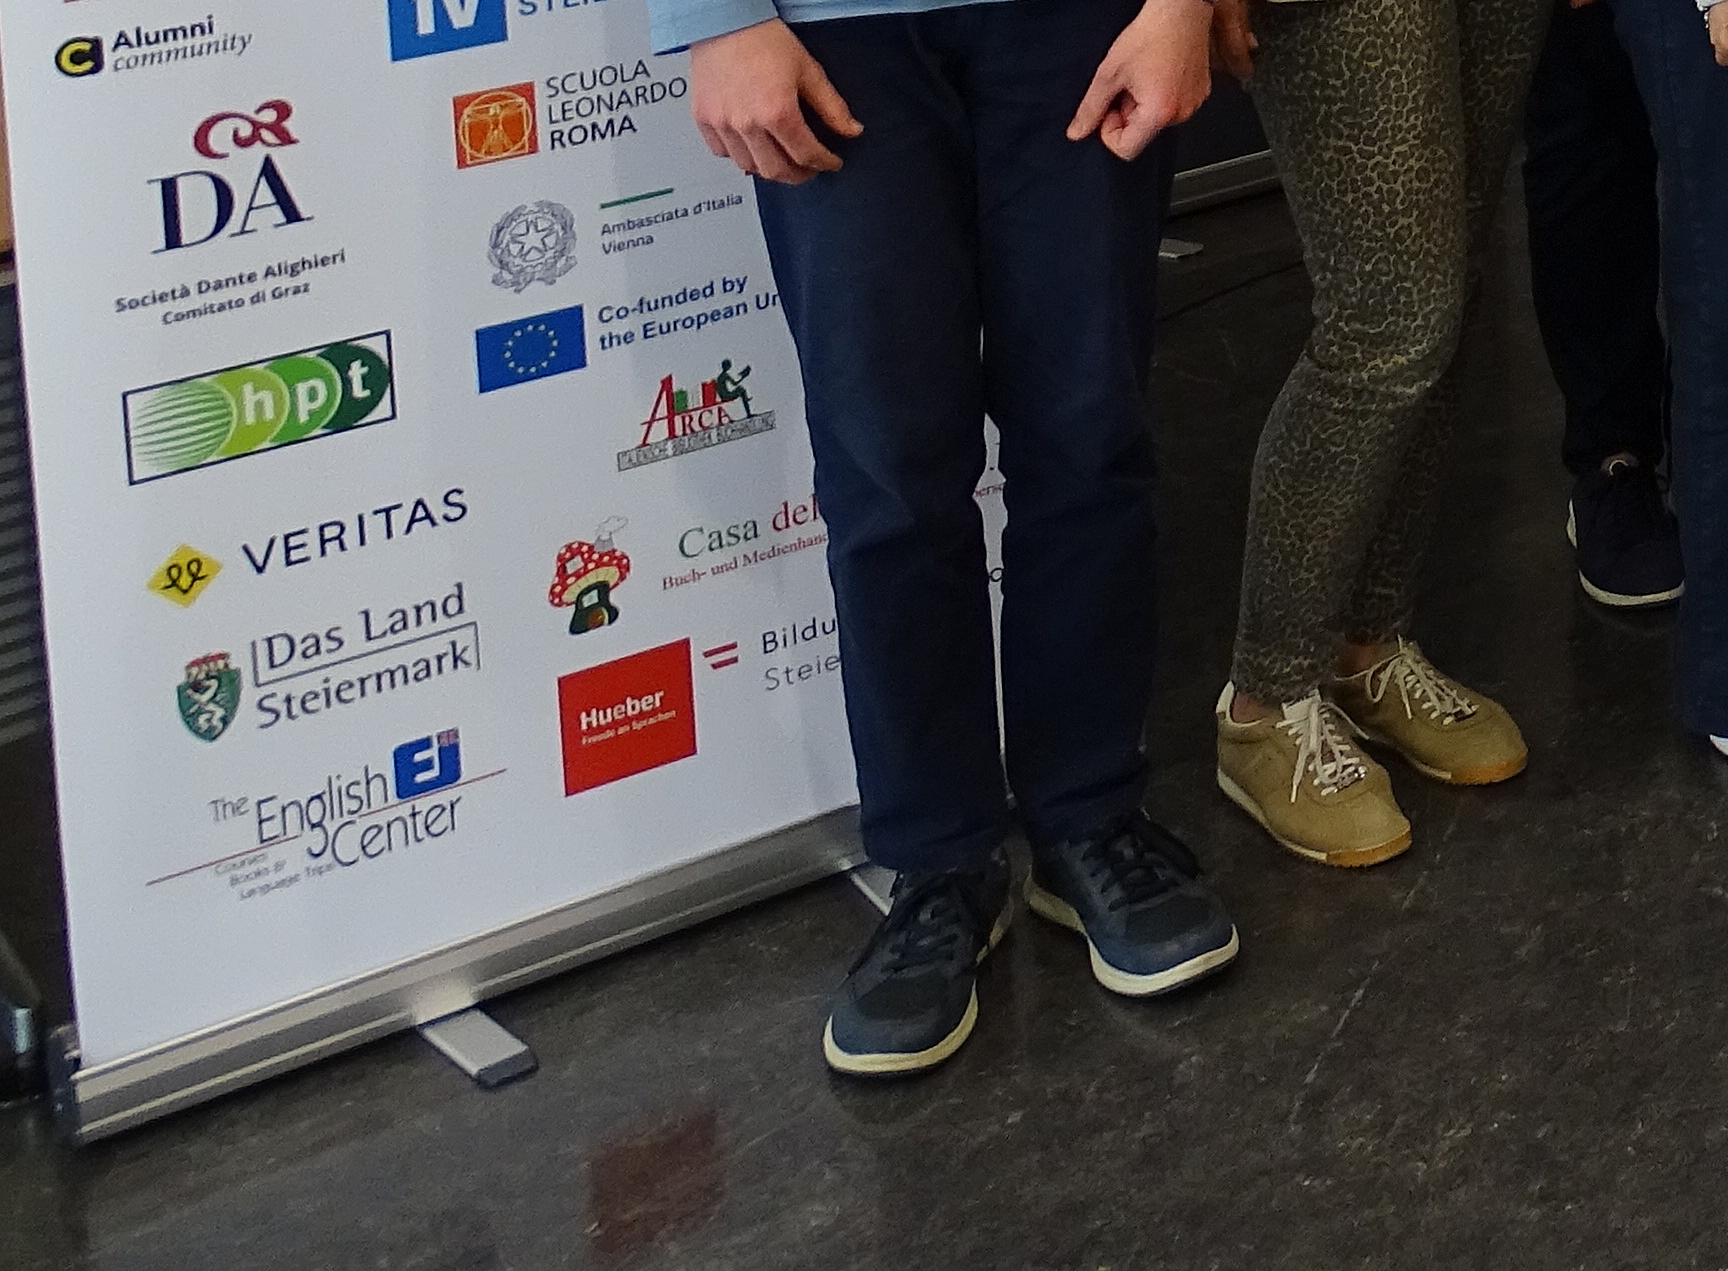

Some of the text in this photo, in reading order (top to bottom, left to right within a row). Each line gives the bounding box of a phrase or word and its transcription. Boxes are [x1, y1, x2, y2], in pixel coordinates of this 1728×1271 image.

[112, 14, 215, 52] Alumni
[112, 32, 253, 73] community
[546, 59, 651, 98] SCUOLA
[548, 76, 688, 125] LEONARDO
[550, 115, 638, 151] ROMA
[147, 153, 314, 255] DA
[600, 192, 744, 237] Ambasciata d'Italia
[602, 233, 655, 256] Vienna
[115, 247, 346, 312] Società Dante Alighieri
[162, 280, 311, 326] Comitato di Graz
[598, 275, 749, 325] Co-funded by
[599, 299, 749, 352] the European
[241, 358, 371, 426] hpt
[241, 487, 470, 575] VERITAS
[678, 518, 760, 560] Casa
[662, 557, 738, 592] Buch- und
[266, 581, 466, 671] Das Land
[256, 639, 474, 730] Steiermark
[580, 690, 665, 731] Hueber
[209, 764, 389, 859] The English
[331, 795, 463, 868] Center
